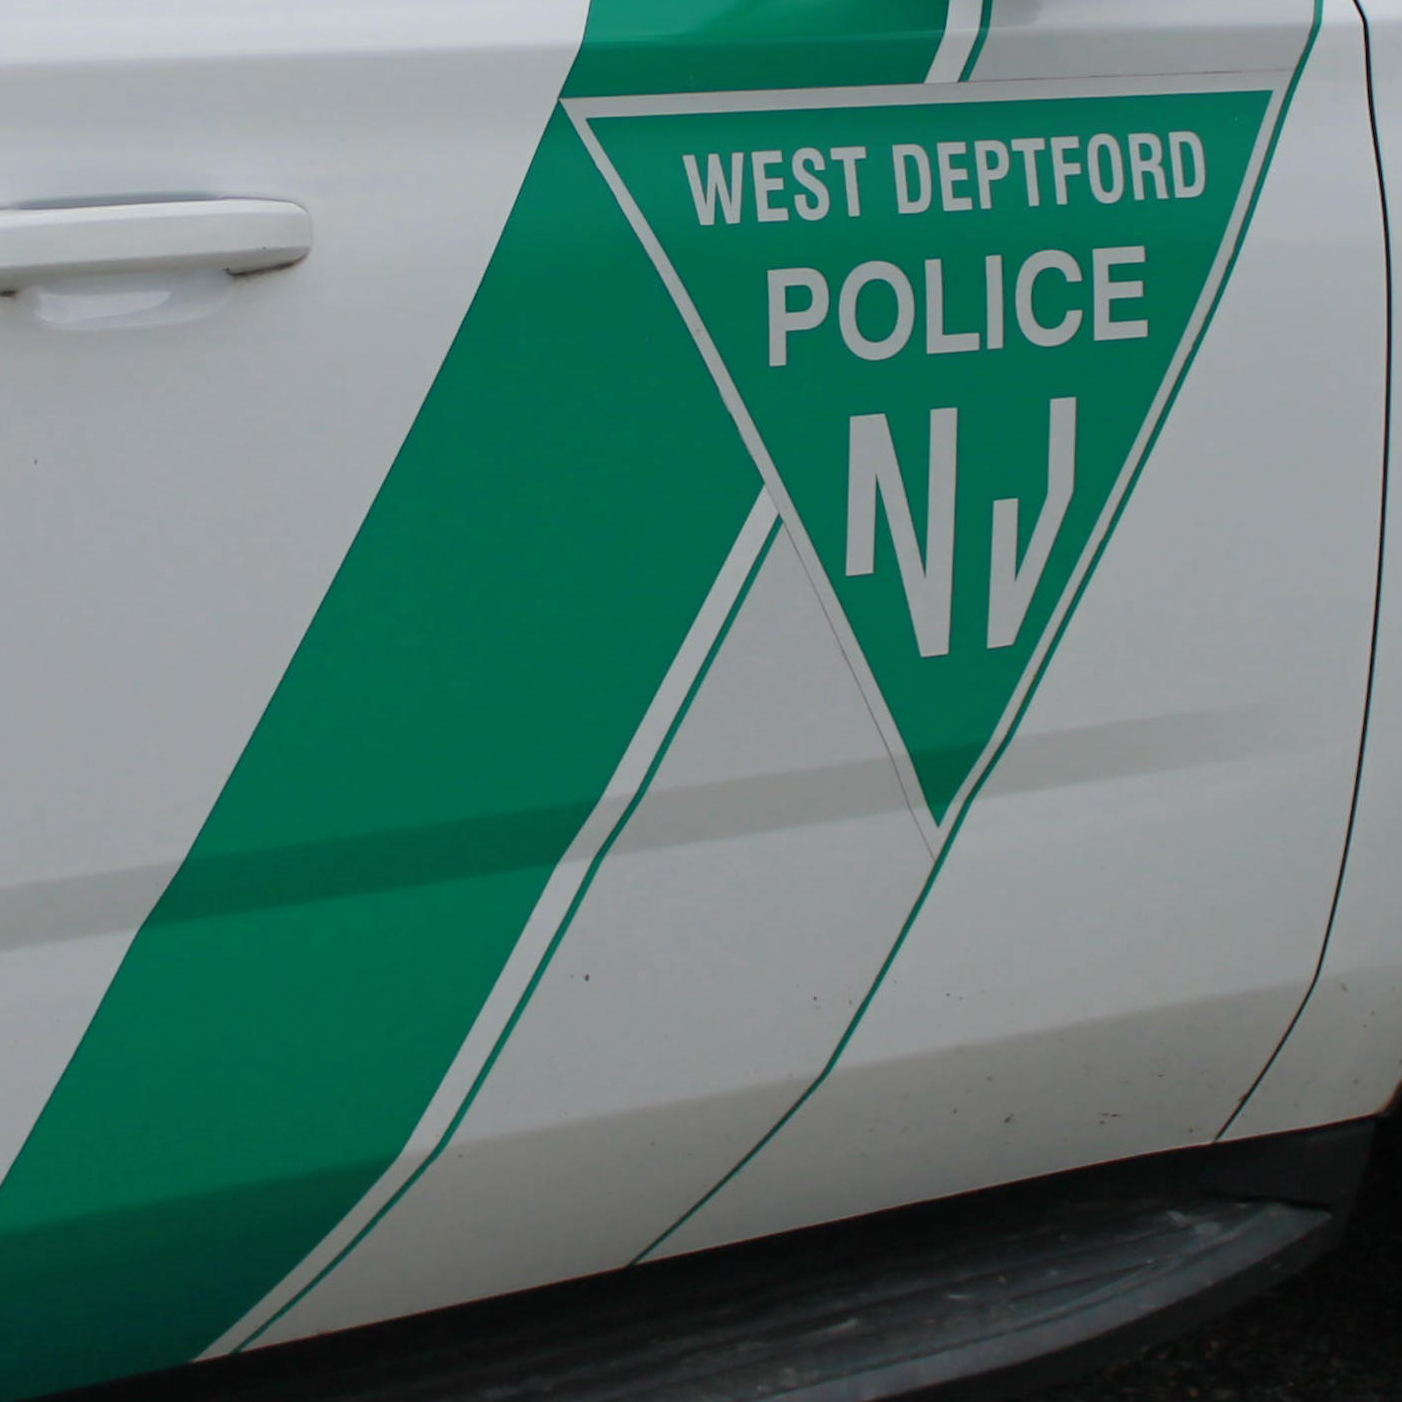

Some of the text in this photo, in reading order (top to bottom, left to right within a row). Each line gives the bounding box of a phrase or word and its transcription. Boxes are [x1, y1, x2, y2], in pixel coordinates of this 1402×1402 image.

[683, 131, 1206, 225] WEST DEPTFORD
[767, 246, 1148, 367] POLICE
[845, 397, 1076, 658] NJ
